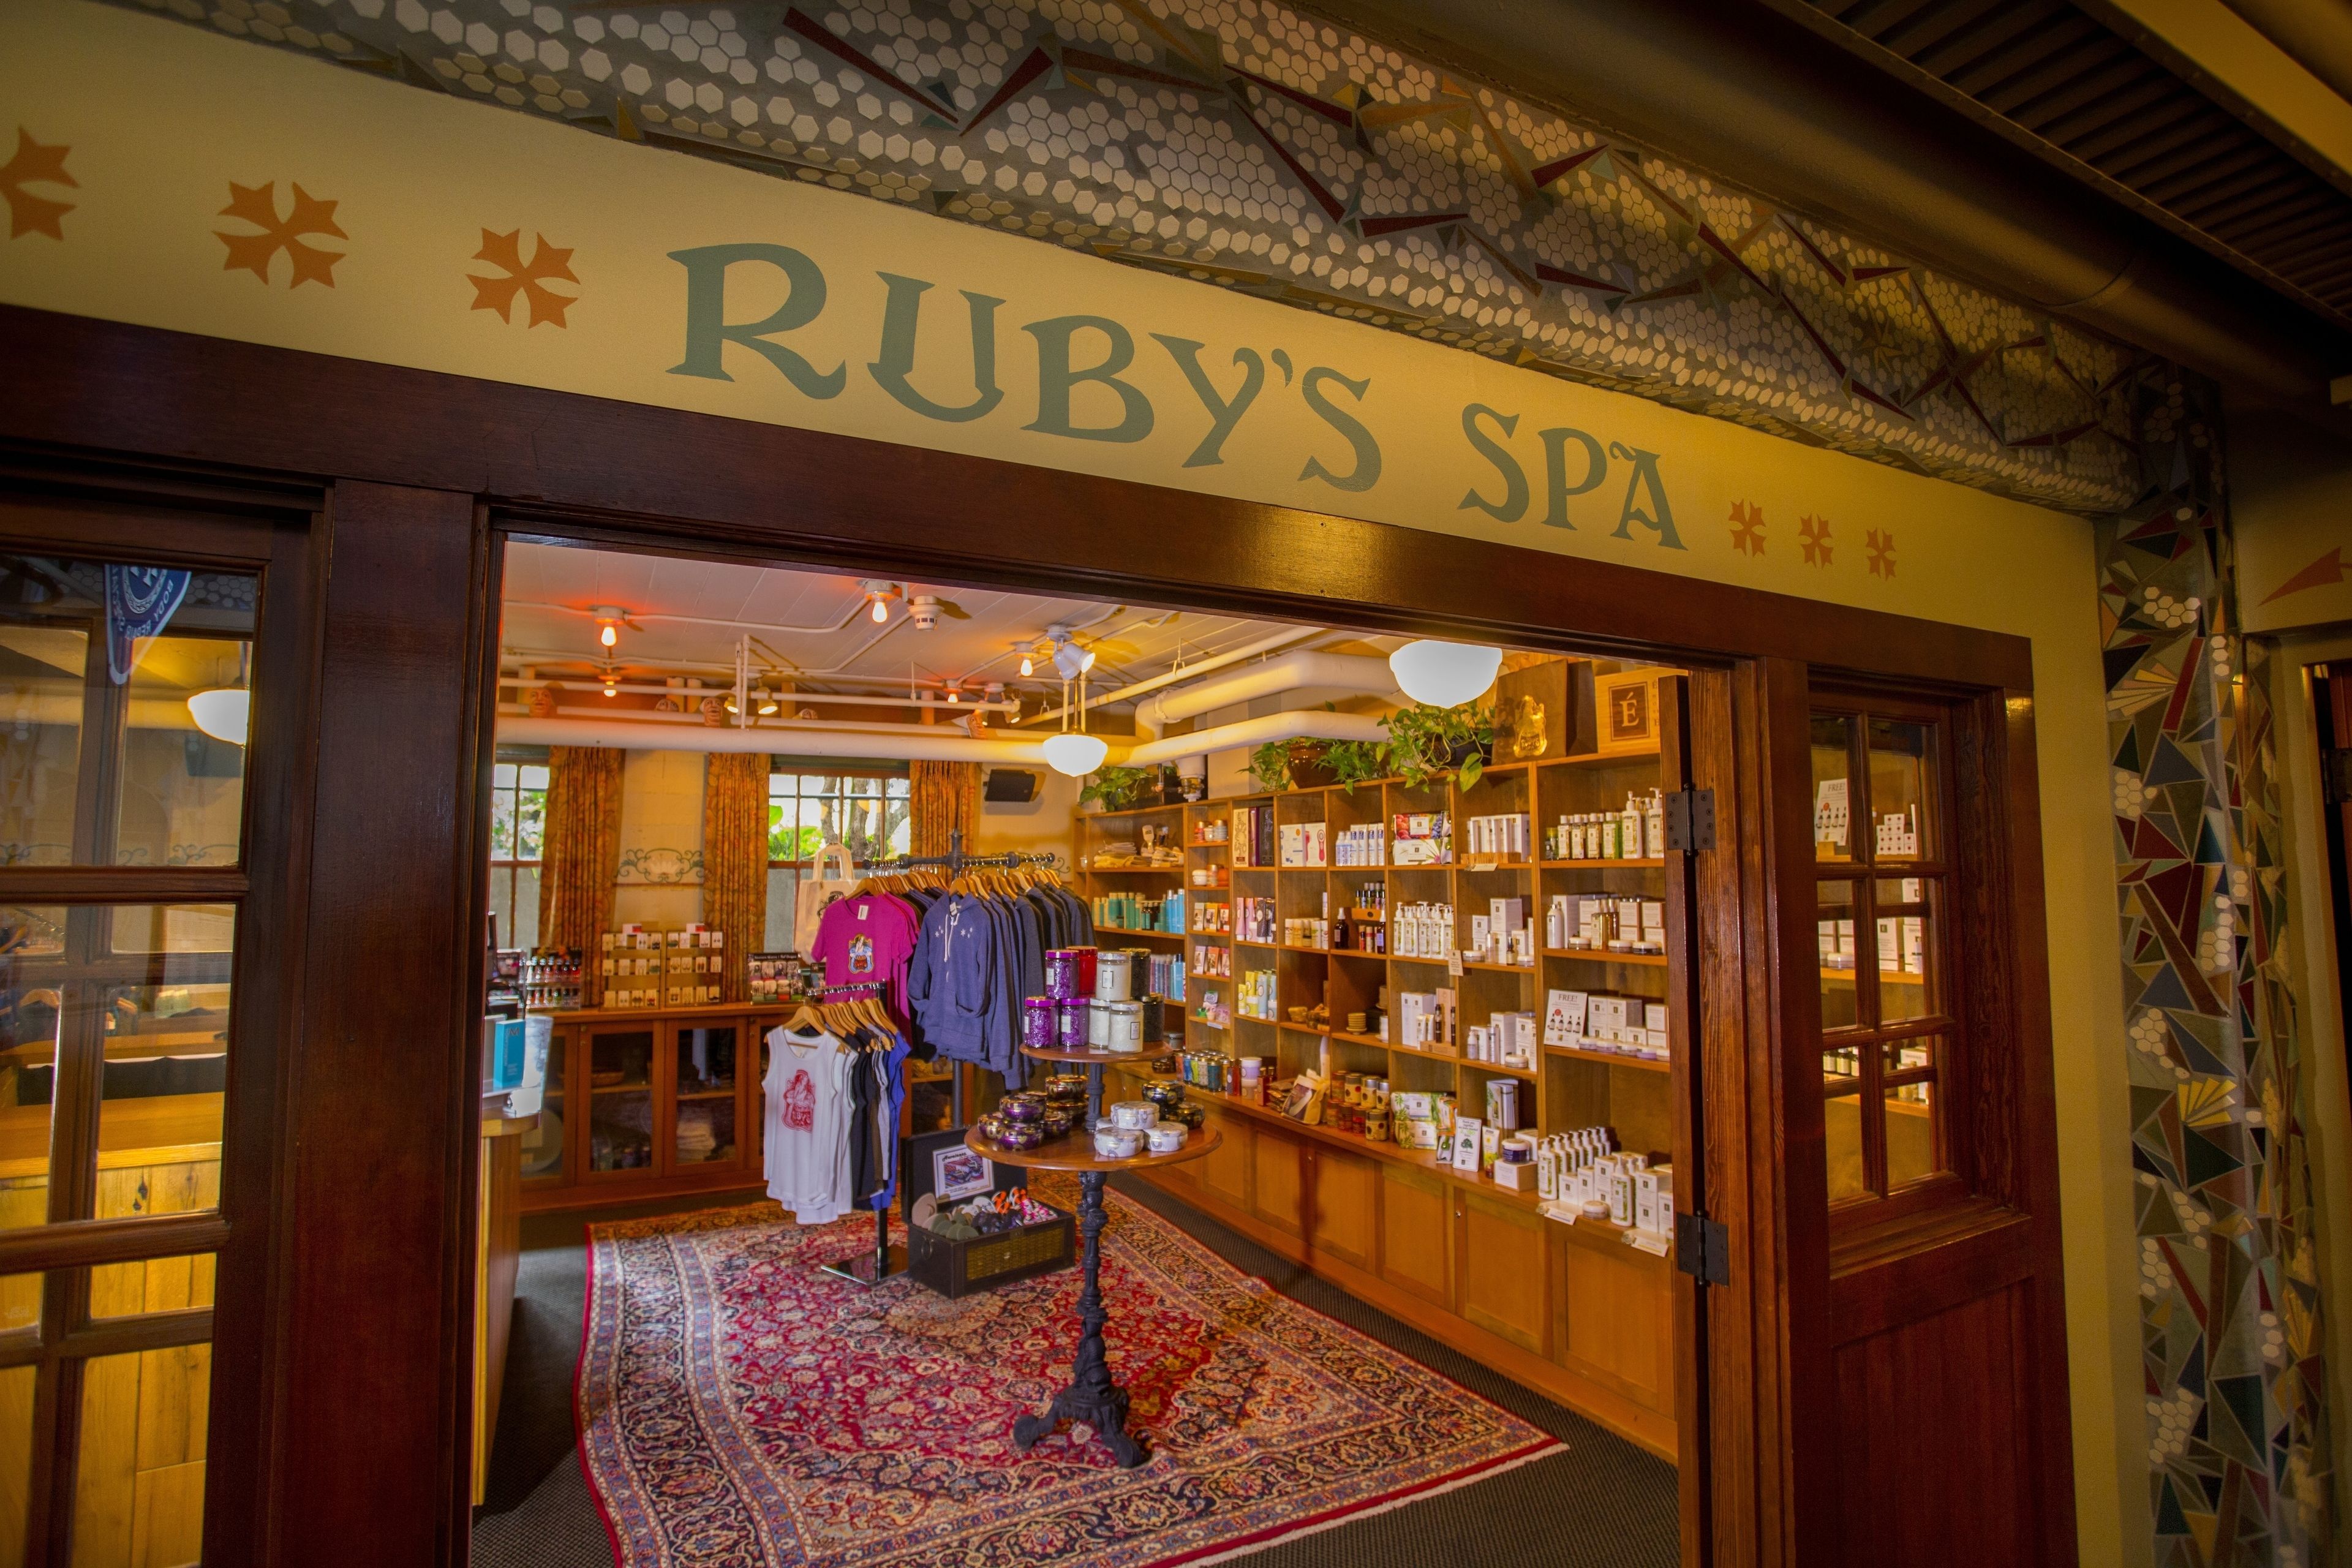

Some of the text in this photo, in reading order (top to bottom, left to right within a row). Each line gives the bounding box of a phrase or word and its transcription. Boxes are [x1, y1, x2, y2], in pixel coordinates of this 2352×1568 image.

[665, 243, 1689, 551] RUBY'S SPA
[1827, 783, 1845, 792] FREE!
[1558, 993, 1578, 1002] FREE!
